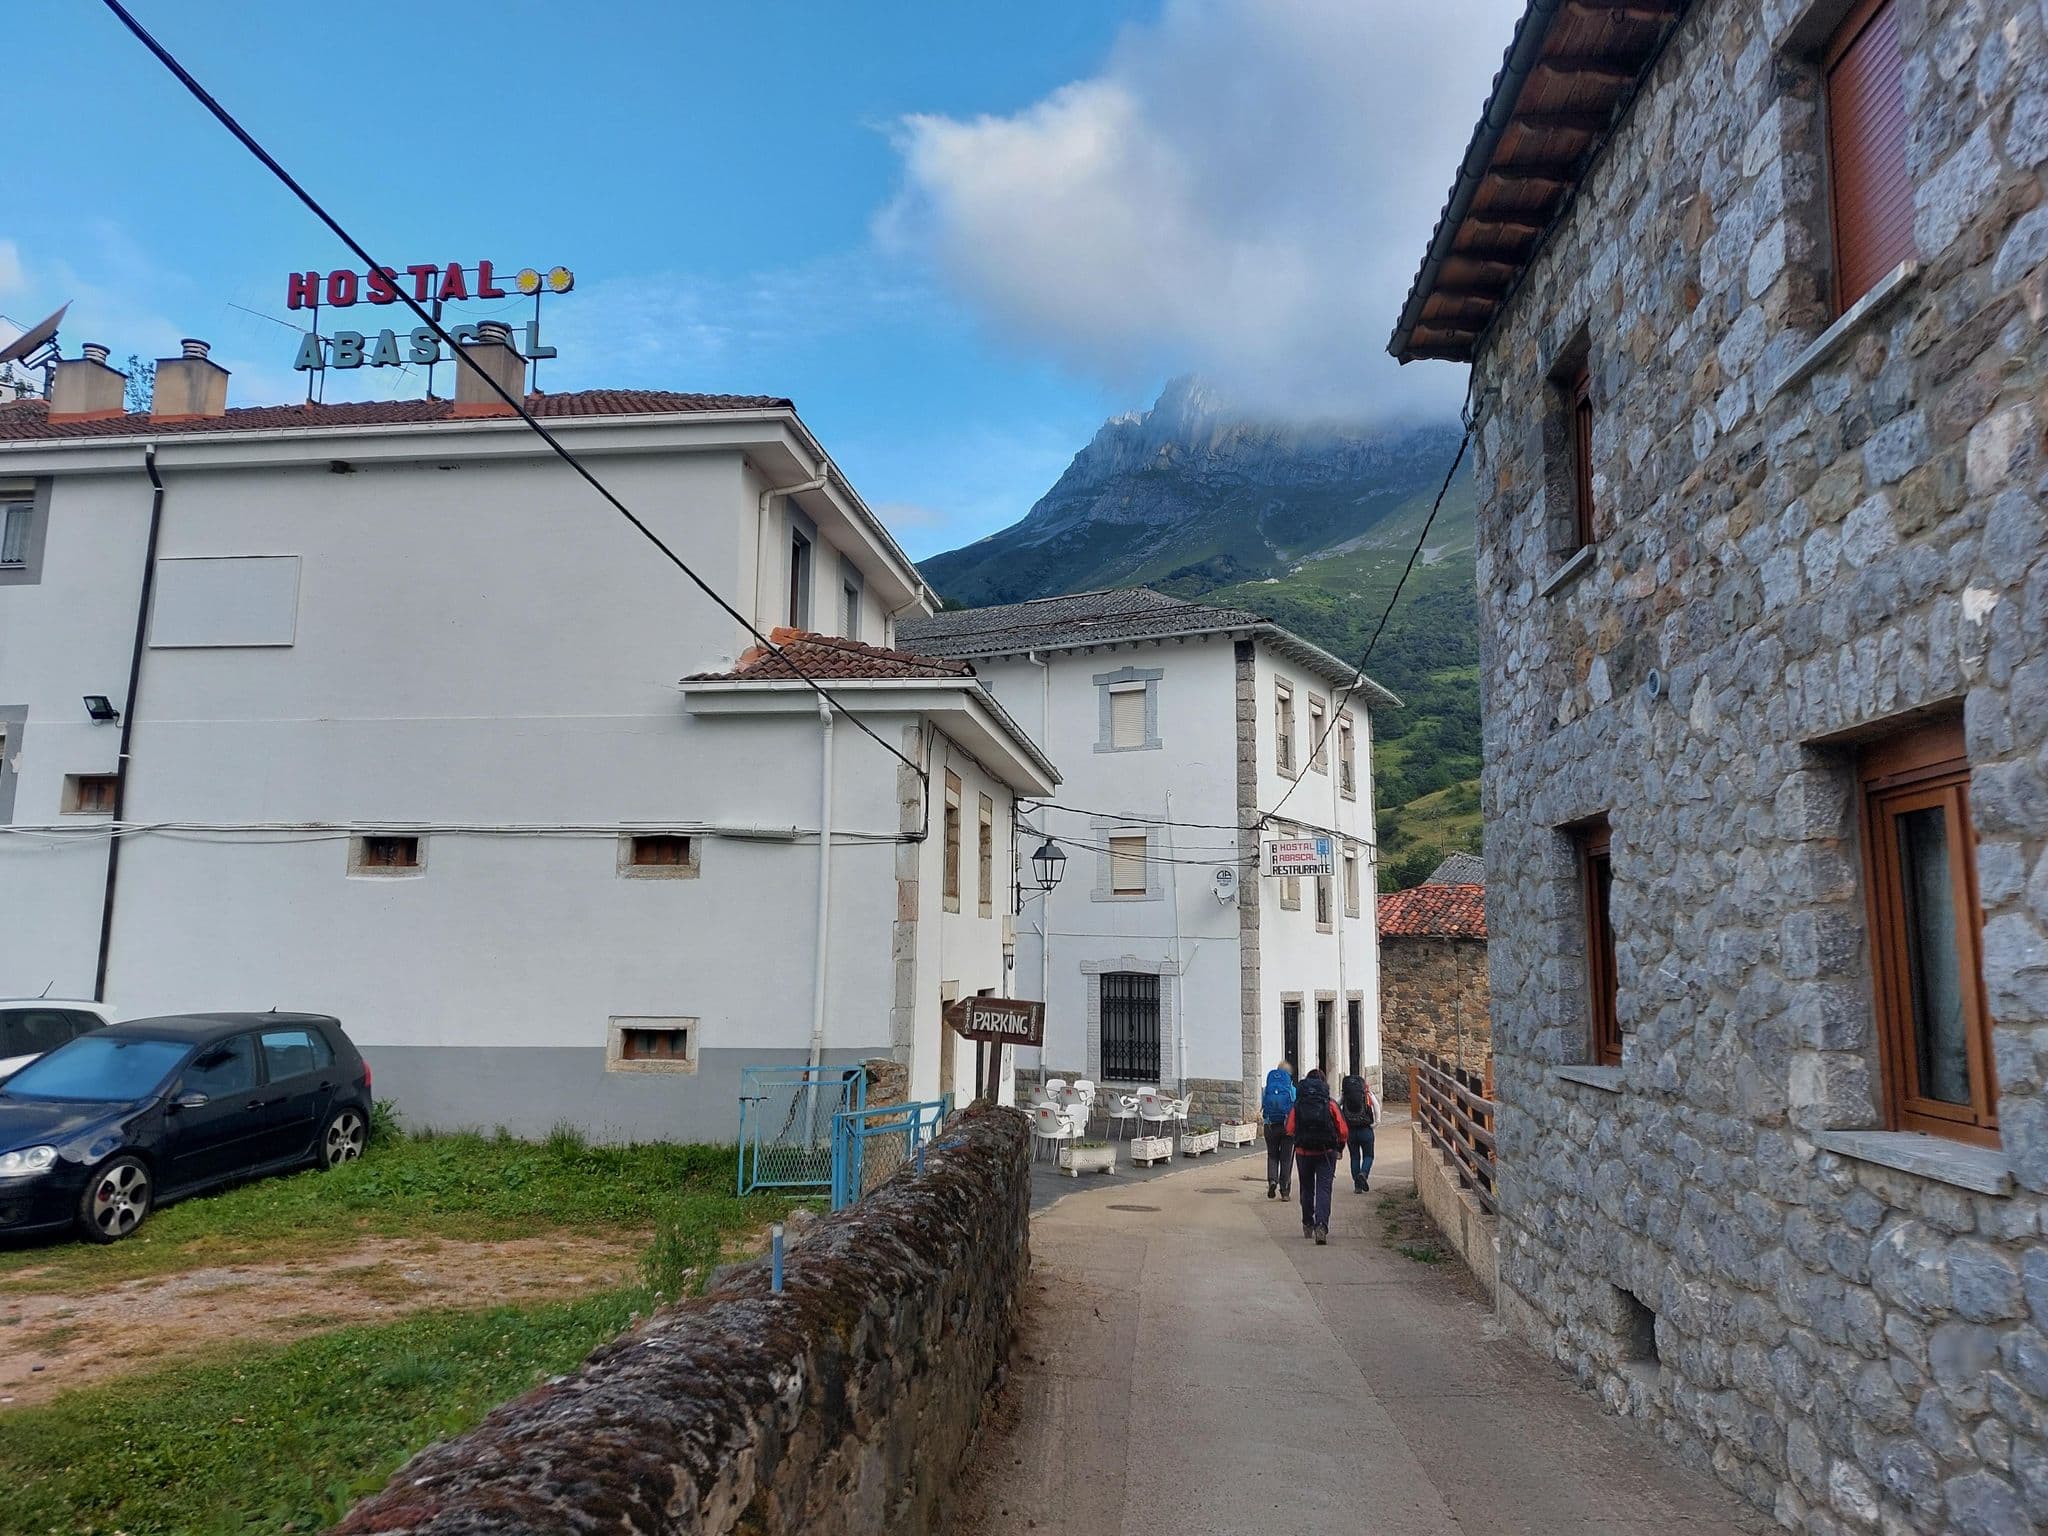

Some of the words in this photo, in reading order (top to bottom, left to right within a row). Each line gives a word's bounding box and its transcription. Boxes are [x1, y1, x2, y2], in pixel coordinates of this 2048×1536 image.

[287, 260, 505, 310] HOSTAL
[293, 321, 557, 371] ABASCL
[1280, 842, 1315, 852] HOSTAL
[1279, 853, 1317, 862] ABASCAL
[1272, 864, 1331, 875] RESTAURANTE
